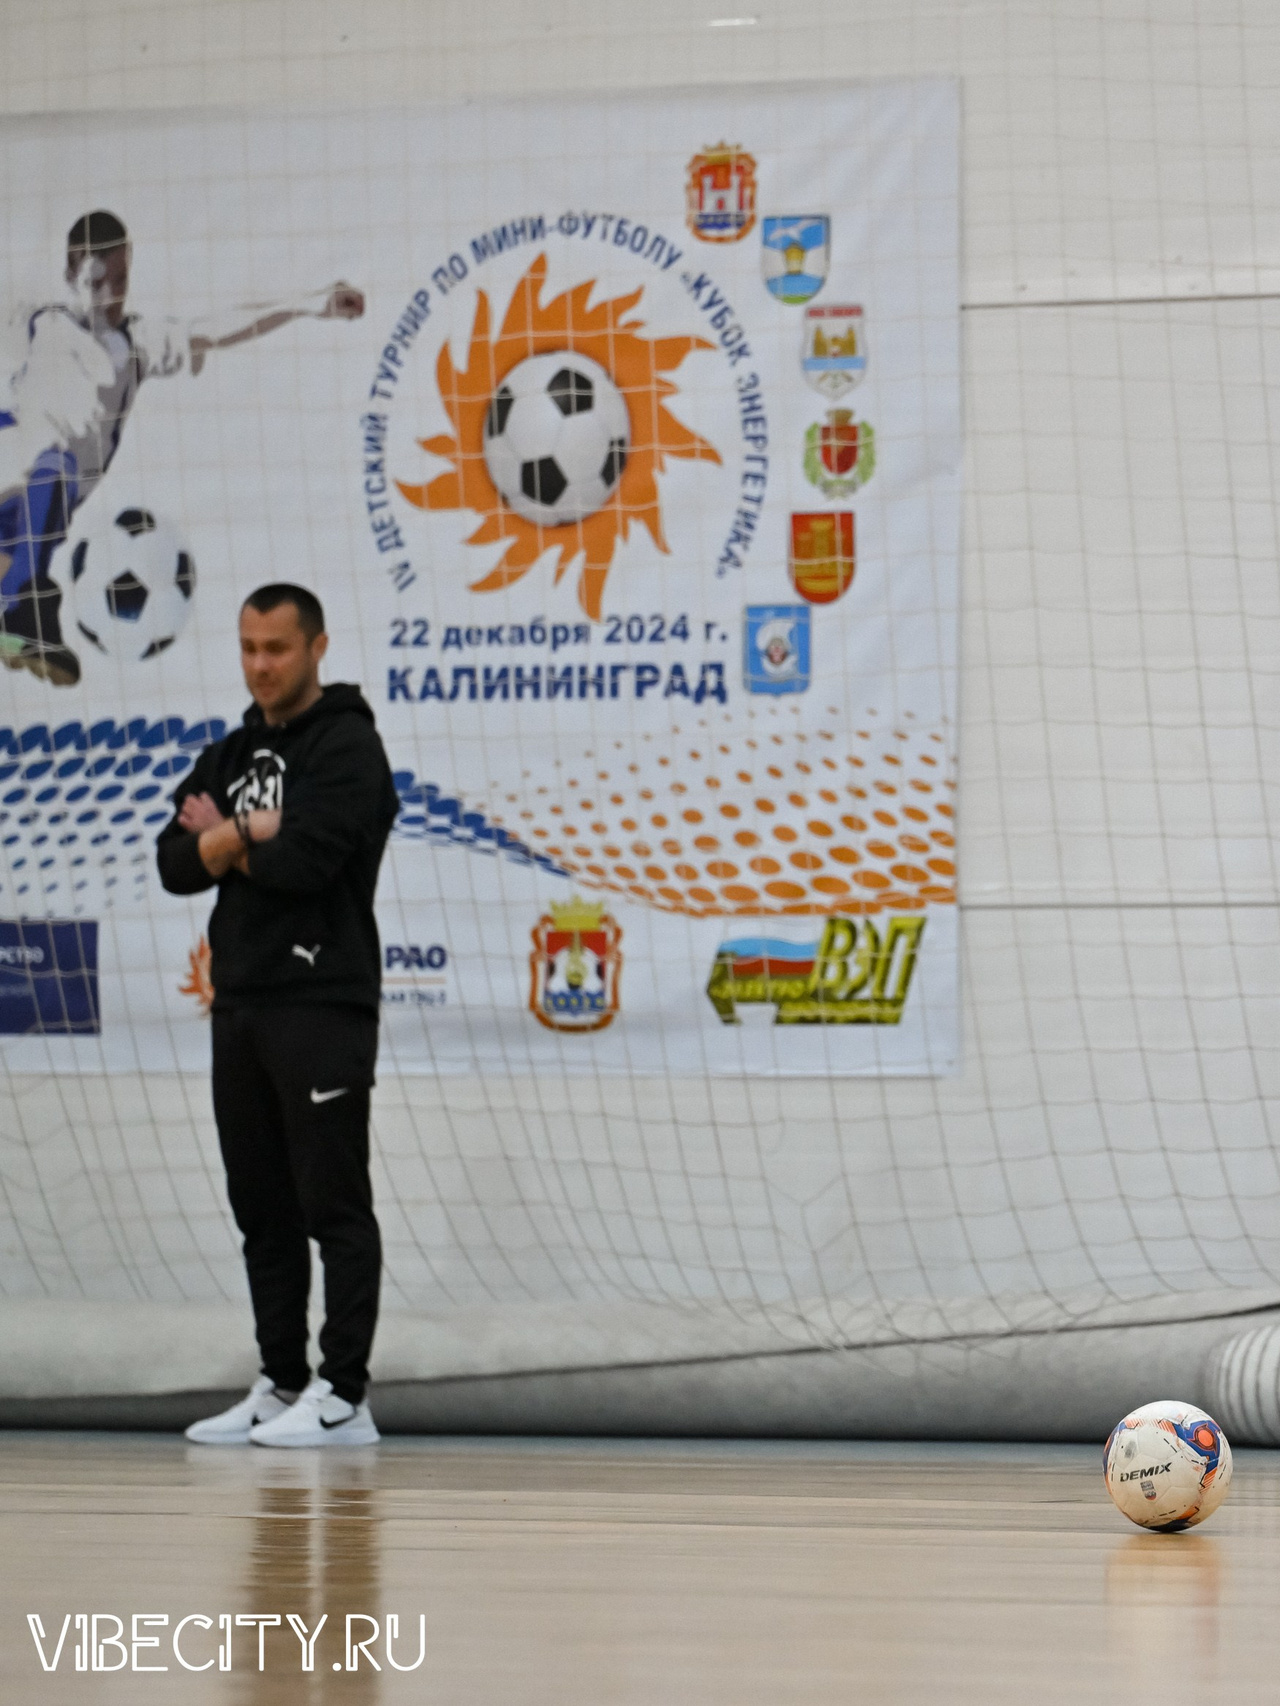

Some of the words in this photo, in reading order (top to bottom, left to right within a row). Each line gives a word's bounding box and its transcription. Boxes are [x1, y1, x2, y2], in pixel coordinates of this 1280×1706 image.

[470, 209, 682, 271] МИНИ-ФУТБОЛУ
[431, 253, 469, 295] ПО
[369, 288, 431, 401] ТУРНИР
[360, 412, 405, 553] ДЕТСКИЙ
[389, 617, 430, 648] 22
[441, 615, 591, 653] декабря
[604, 613, 690, 643] 2024
[704, 621, 729, 643] г.
[387, 663, 728, 704] КАЛИНИНГРАД
[1120, 1462, 1173, 1483] DEMIX
